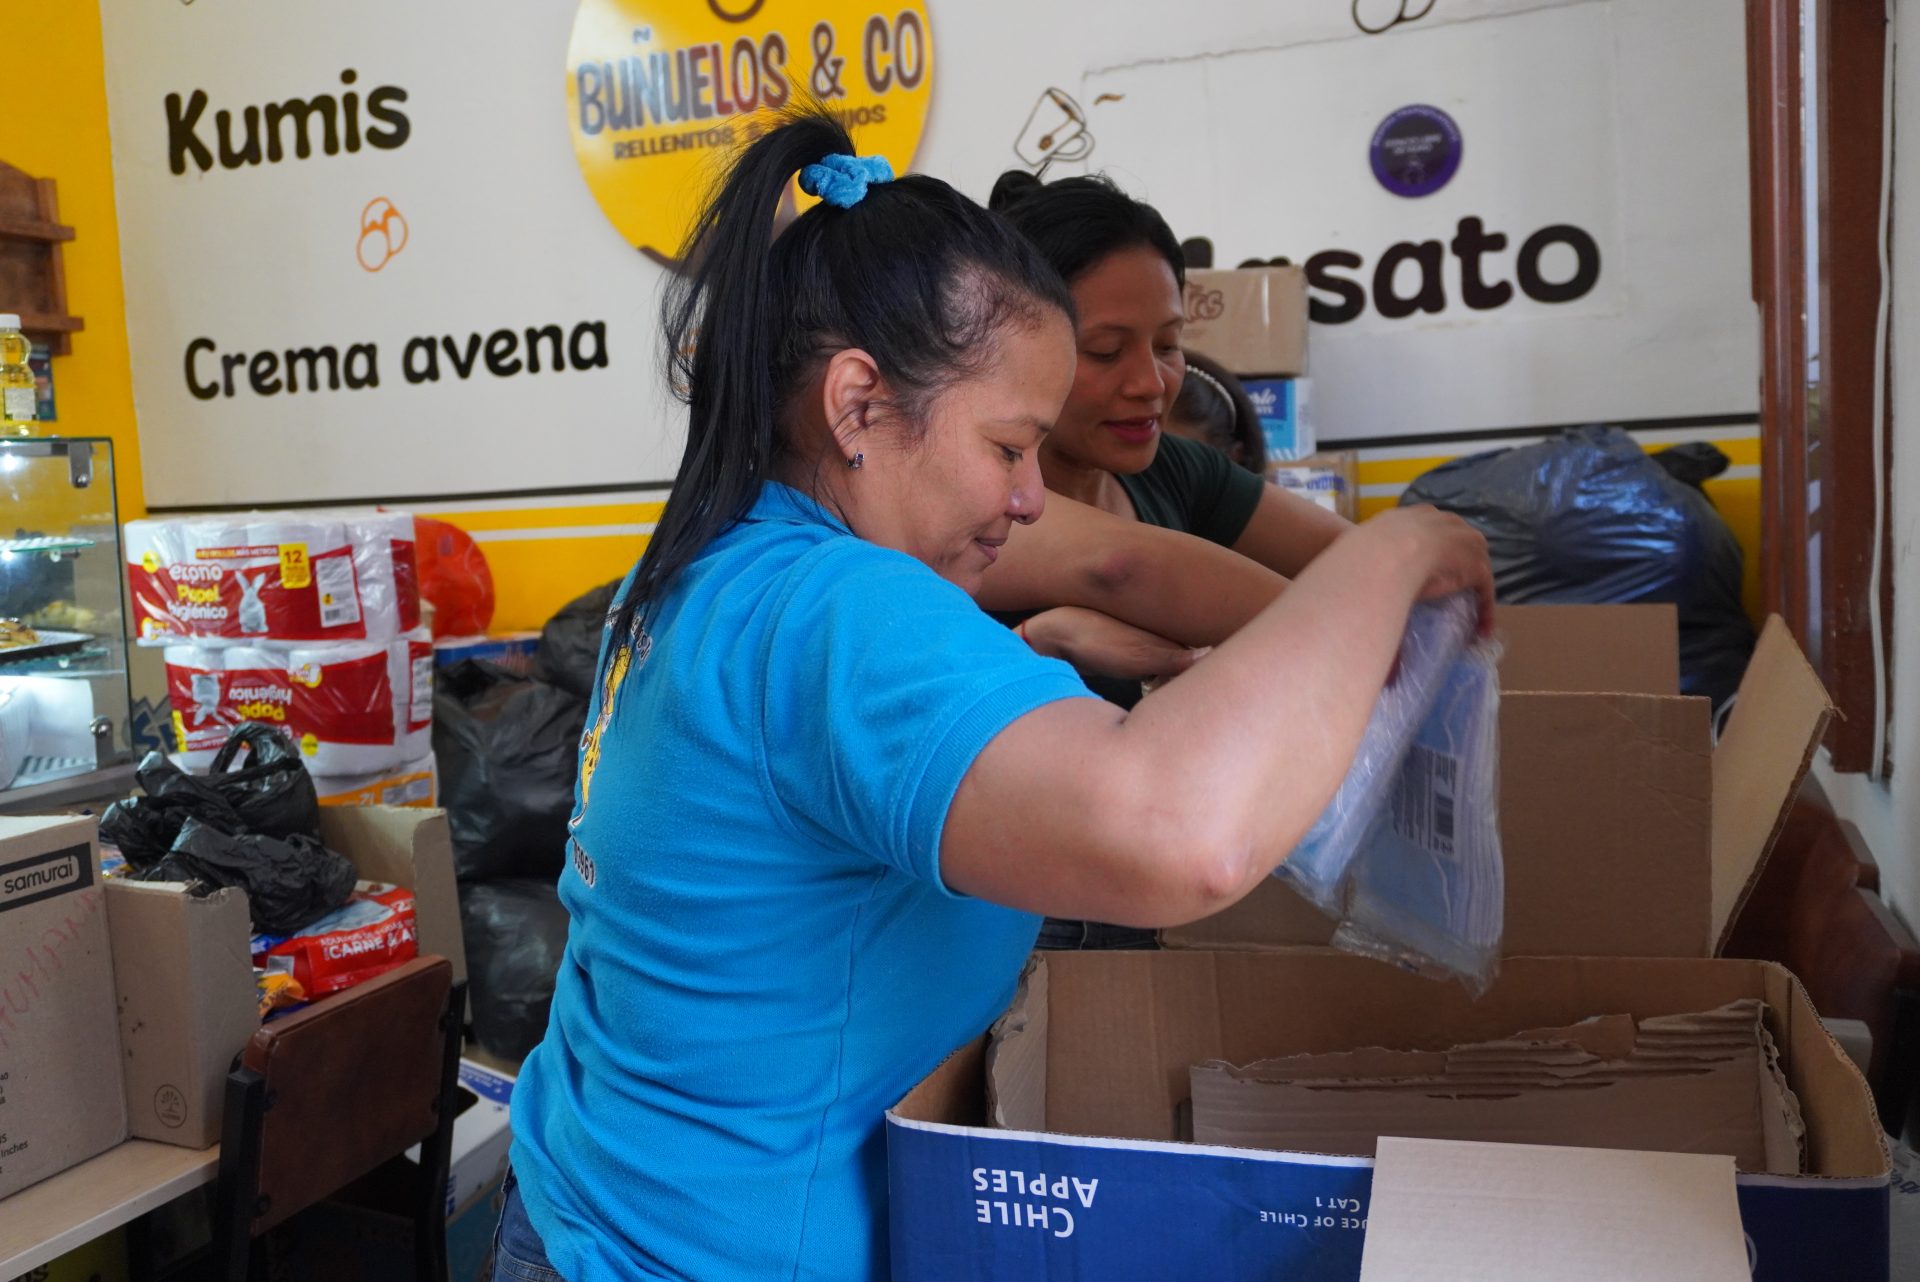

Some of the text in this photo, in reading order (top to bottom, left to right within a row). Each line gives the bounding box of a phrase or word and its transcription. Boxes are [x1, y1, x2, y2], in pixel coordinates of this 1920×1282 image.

[577, 28, 790, 135] BUÑUELOS
[811, 21, 845, 98] &
[864, 10, 924, 94] CO
[164, 68, 411, 176] Kumis
[614, 126, 733, 160] RELLENITOS
[1181, 216, 1601, 325] sato
[184, 320, 609, 400] Crema avena
[284, 550, 303, 565] 12
[4, 855, 74, 895] samurai
[329, 936, 385, 960] CARNE
[972, 1167, 1099, 1208] APPLES
[1315, 1196, 1361, 1213] CAT 1
[976, 1199, 1075, 1238] CHILE
[1260, 1210, 1308, 1228] CHILE
[1314, 1216, 1335, 1228] OF
